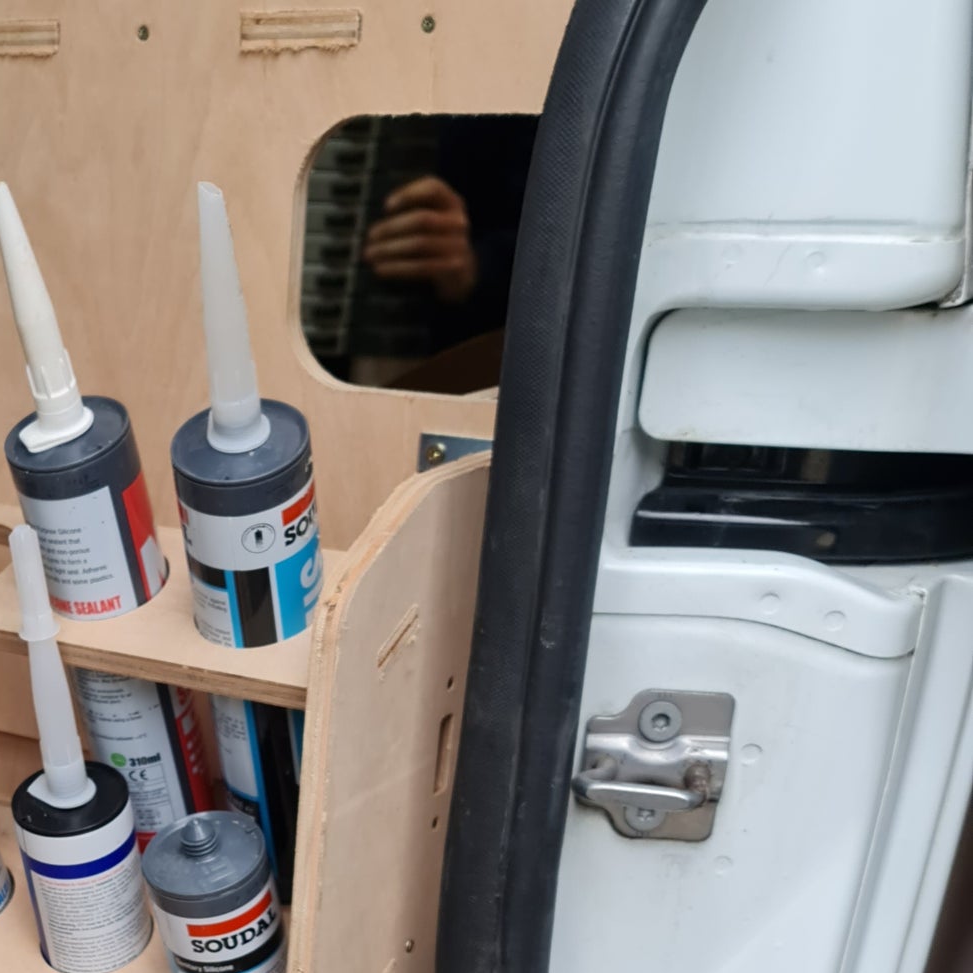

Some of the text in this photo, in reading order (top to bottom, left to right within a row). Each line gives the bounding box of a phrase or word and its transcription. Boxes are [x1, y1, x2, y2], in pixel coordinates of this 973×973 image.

[74, 595, 122, 616] SEALANT
[128, 753, 162, 768] 310ml
[190, 908, 277, 954] SOUDAL
